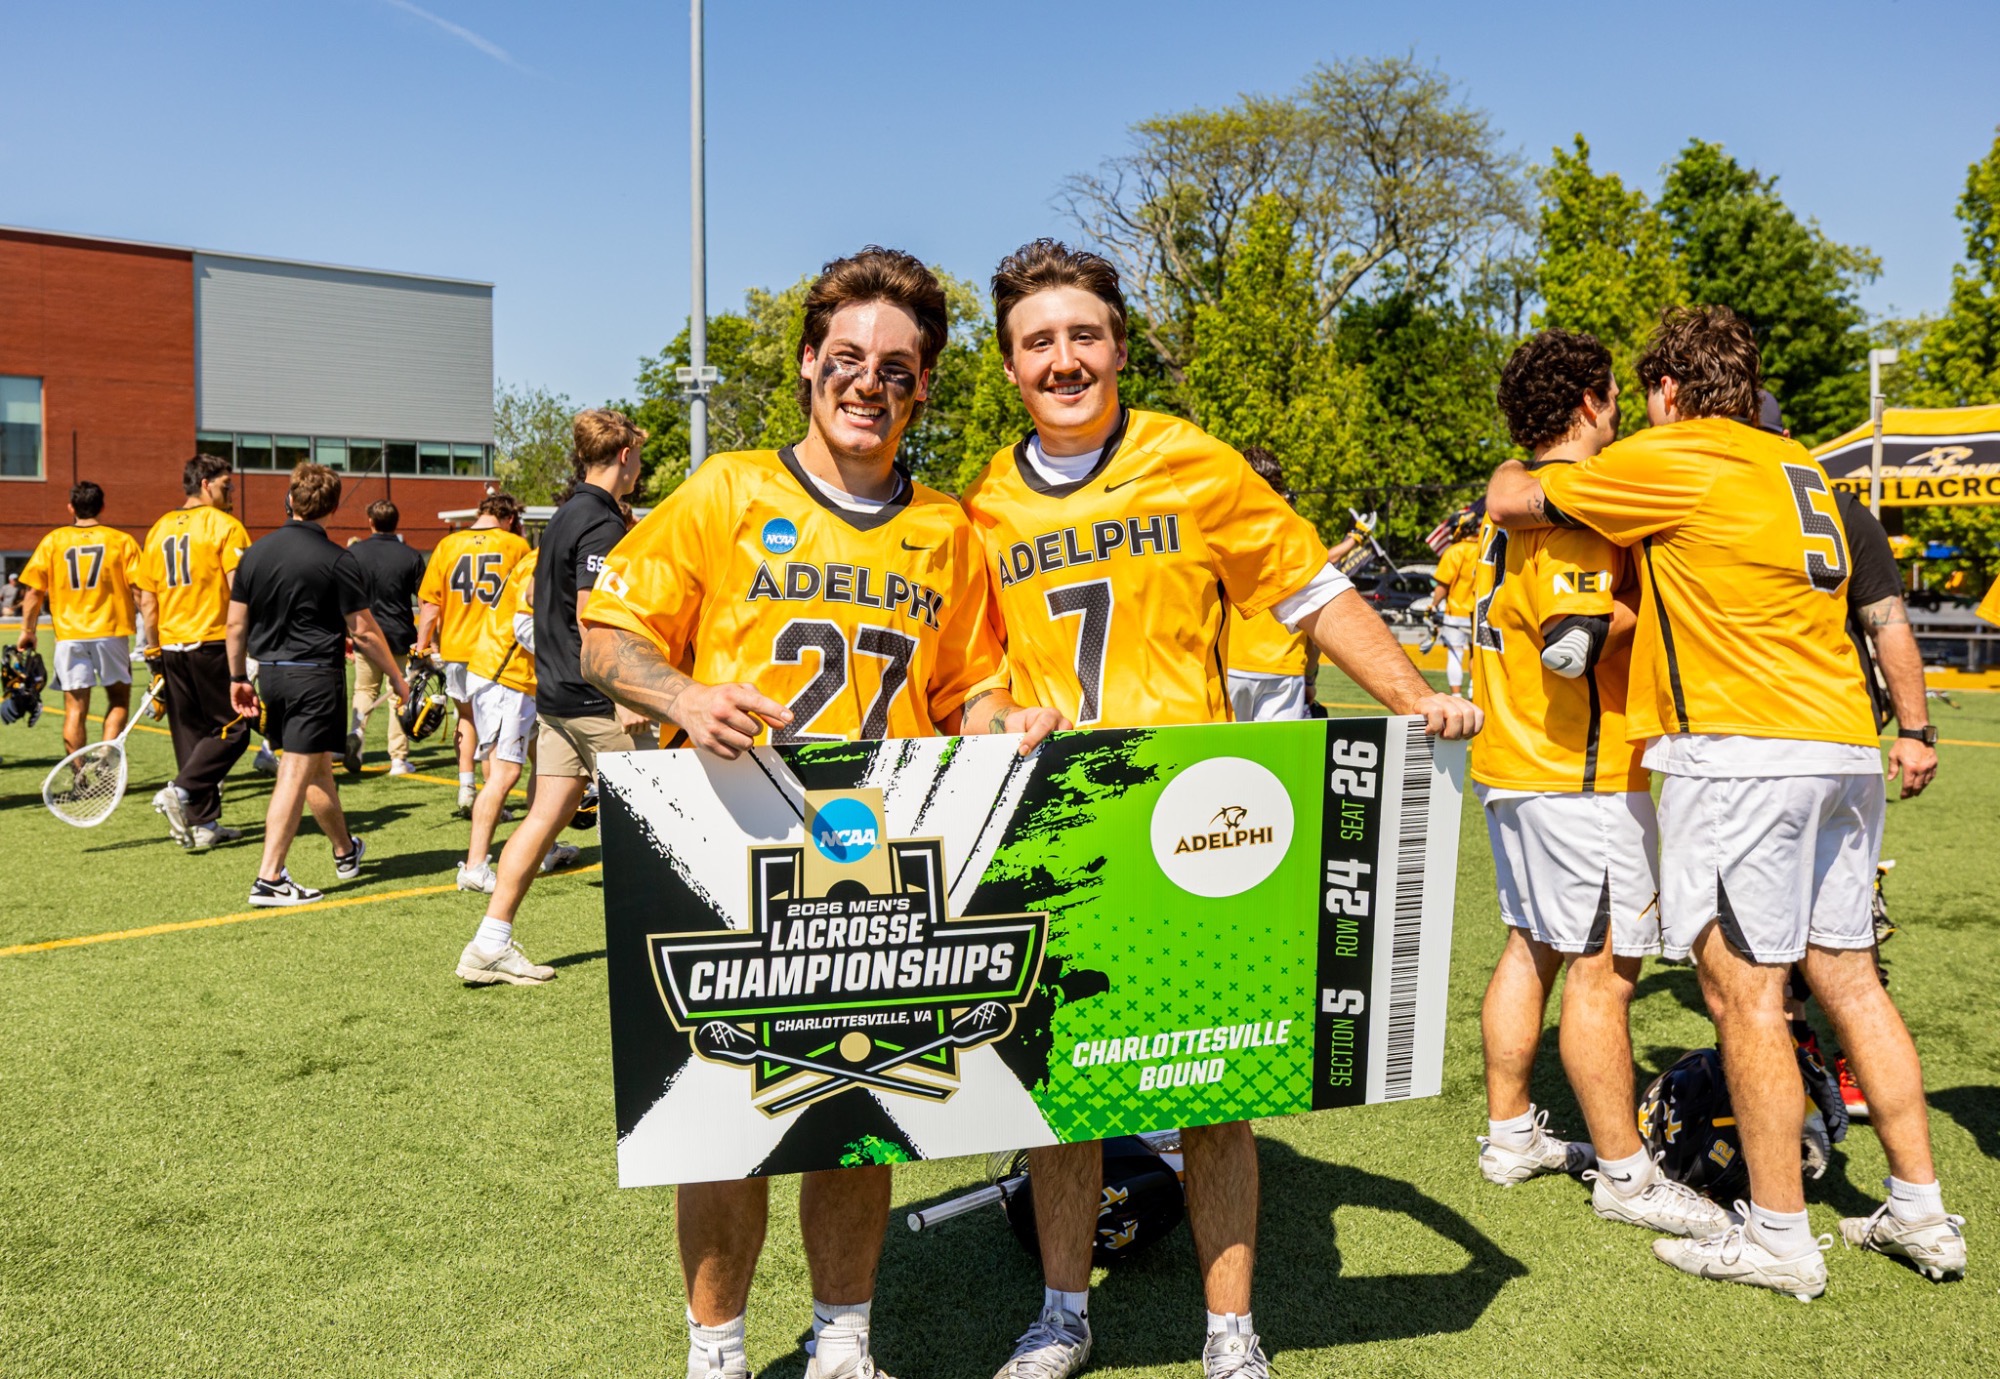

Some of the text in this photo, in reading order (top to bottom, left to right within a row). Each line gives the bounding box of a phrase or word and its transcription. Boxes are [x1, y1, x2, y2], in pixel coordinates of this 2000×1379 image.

[765, 534, 796, 546] NCAA
[1780, 462, 1849, 594] 5
[64, 543, 105, 590] 17
[162, 533, 192, 588] 11
[998, 514, 1181, 592] ADELPHI
[450, 552, 503, 611] 45
[745, 560, 944, 631] ADELPHI
[1043, 577, 1114, 728] 7
[766, 617, 920, 744] 27
[819, 828, 876, 848] NCAA
[1174, 826, 1273, 855] ADELPHI
[770, 912, 927, 951] LACROSSE
[787, 898, 911, 917] 2026 MEN'S
[1322, 739, 1378, 1087] SECTION 5 ROW 24 SEAT 26
[688, 942, 1015, 1002] CHAMPIONSHIPS
[774, 1009, 932, 1033] CHARLOTTESVILLE, VA
[1072, 1019, 1292, 1067] CHARLOTTESVILLE
[1138, 1058, 1226, 1092] BOUND
[1708, 1139, 1736, 1169] 12
